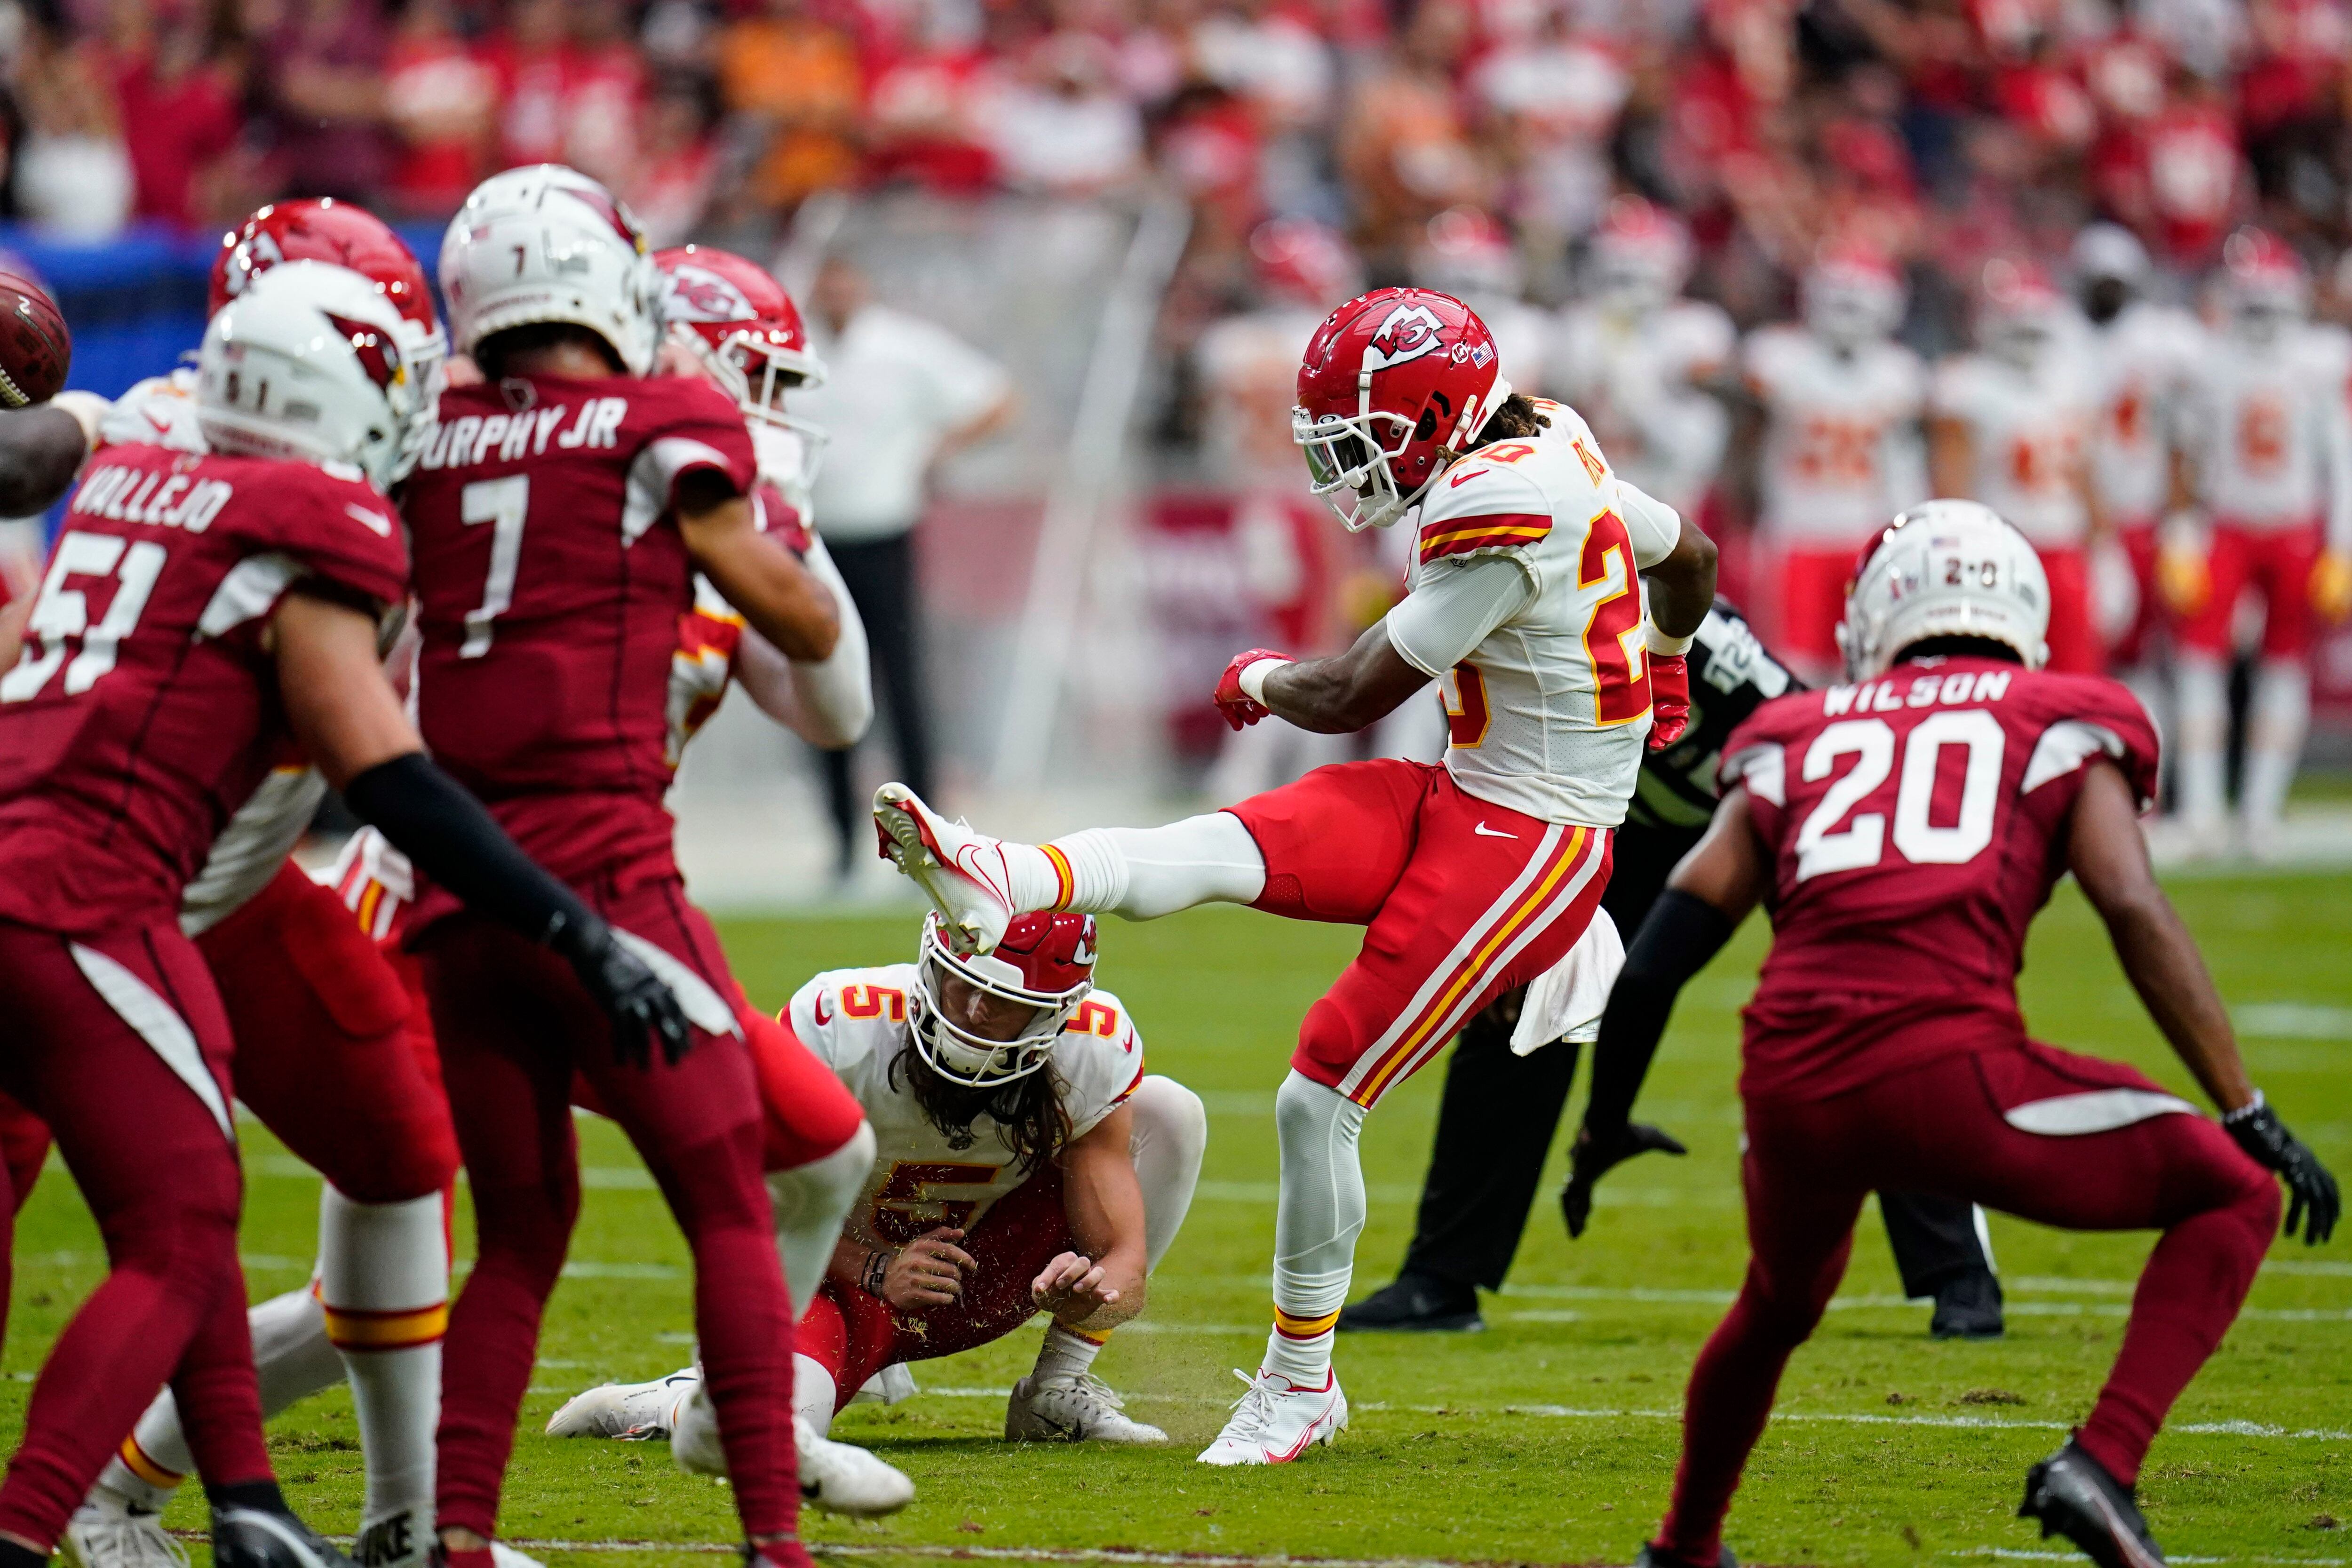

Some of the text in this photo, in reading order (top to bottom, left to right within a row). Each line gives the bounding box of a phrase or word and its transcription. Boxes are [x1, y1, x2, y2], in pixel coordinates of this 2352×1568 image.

[420, 396, 628, 470] URPHY JR
[1, 530, 168, 704] 51
[458, 474, 530, 658] 7
[1824, 670, 2012, 717] WILSON
[1795, 708, 2005, 883] 20
[839, 983, 907, 1023] 5
